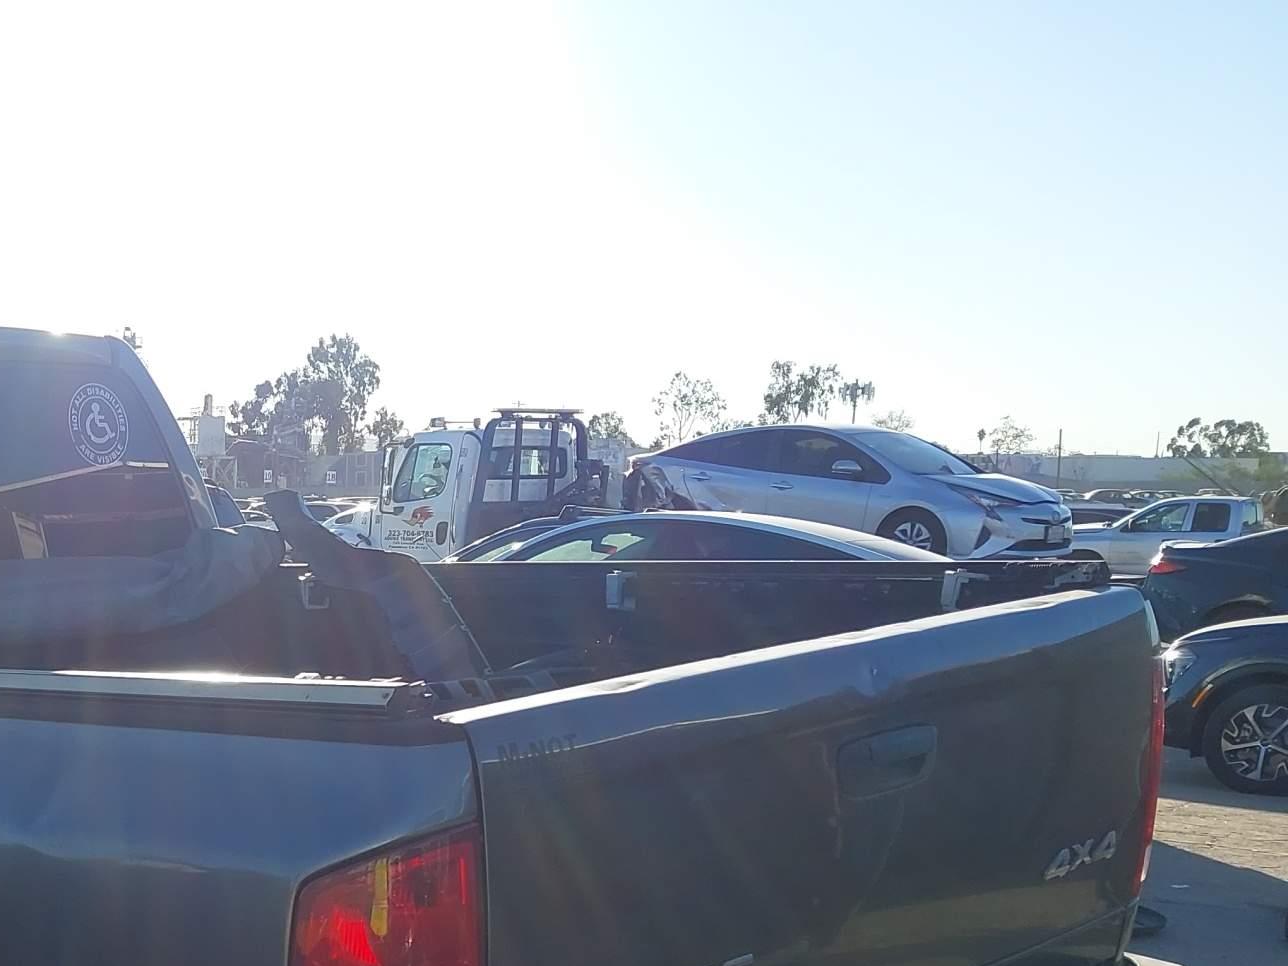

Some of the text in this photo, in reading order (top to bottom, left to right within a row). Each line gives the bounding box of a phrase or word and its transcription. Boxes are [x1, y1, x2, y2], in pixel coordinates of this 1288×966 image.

[86, 386, 126, 432] DISABILITIES
[79, 442, 124, 464] ARE VISIBLE
[1043, 830, 1117, 880] 4X4
